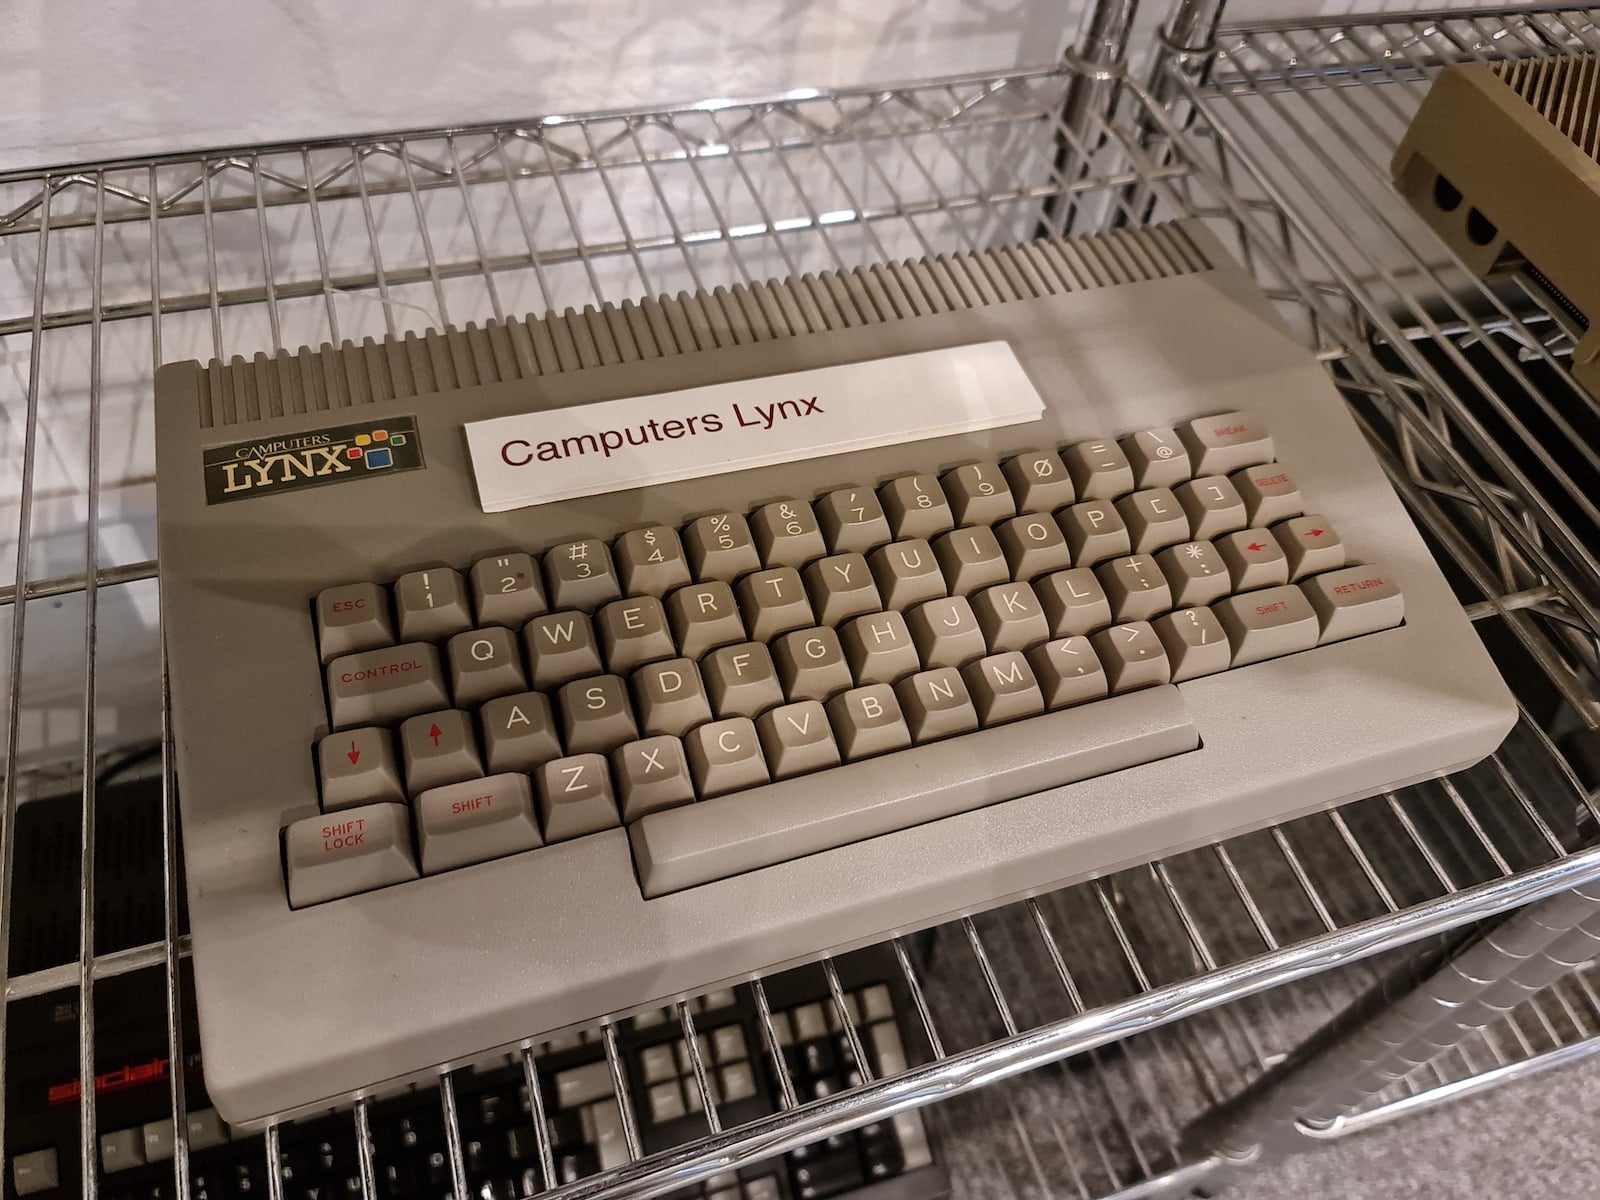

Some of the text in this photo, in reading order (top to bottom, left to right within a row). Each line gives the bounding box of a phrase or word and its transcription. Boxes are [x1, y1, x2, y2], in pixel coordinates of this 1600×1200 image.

[500, 395, 826, 466] Camputers Lynx
[1156, 446, 1173, 459] @
[222, 444, 352, 494] LYNX
[978, 482, 995, 496] 9
[1255, 474, 1288, 488] DELETE
[916, 494, 934, 511] 8
[1207, 485, 1225, 501] ]
[779, 503, 797, 520] &
[850, 507, 865, 522] 7
[1150, 498, 1167, 514] [
[710, 515, 730, 533] %
[785, 520, 802, 536] 6
[1086, 510, 1105, 528] P
[644, 530, 656, 546] $
[718, 534, 734, 549] 5
[1027, 523, 1048, 541] O
[568, 542, 588, 561] #
[646, 547, 663, 564] 4
[900, 549, 922, 569] U
[576, 562, 592, 578] 3
[833, 563, 851, 583] Y
[1126, 557, 1143, 572] +
[501, 576, 517, 593] 2
[765, 577, 784, 599] T
[1065, 580, 1091, 598] L
[1333, 579, 1384, 596] RETURN
[333, 598, 366, 613] ESC
[697, 592, 718, 613] R
[1002, 591, 1028, 614] K
[1256, 602, 1285, 615] SHIFT
[623, 607, 646, 630] E
[943, 606, 960, 627] J
[1185, 610, 1199, 626] ?
[542, 620, 574, 644] W
[871, 621, 897, 644] H
[1121, 626, 1140, 642] >
[471, 640, 494, 661] Q
[805, 638, 826, 659] G
[1060, 639, 1079, 655] <
[341, 660, 423, 685] CONTROL
[732, 653, 750, 676] F
[992, 661, 1024, 685] M
[658, 671, 682, 693] D
[928, 678, 954, 701] N
[585, 687, 606, 710] S
[861, 696, 883, 719] B
[506, 705, 531, 729] A
[787, 712, 810, 735] V
[718, 730, 741, 753] C
[640, 747, 665, 774] X
[561, 765, 588, 792] Z
[451, 794, 493, 815] SHIFT
[320, 818, 366, 838] SHIFT
[324, 834, 364, 852] LOCK
